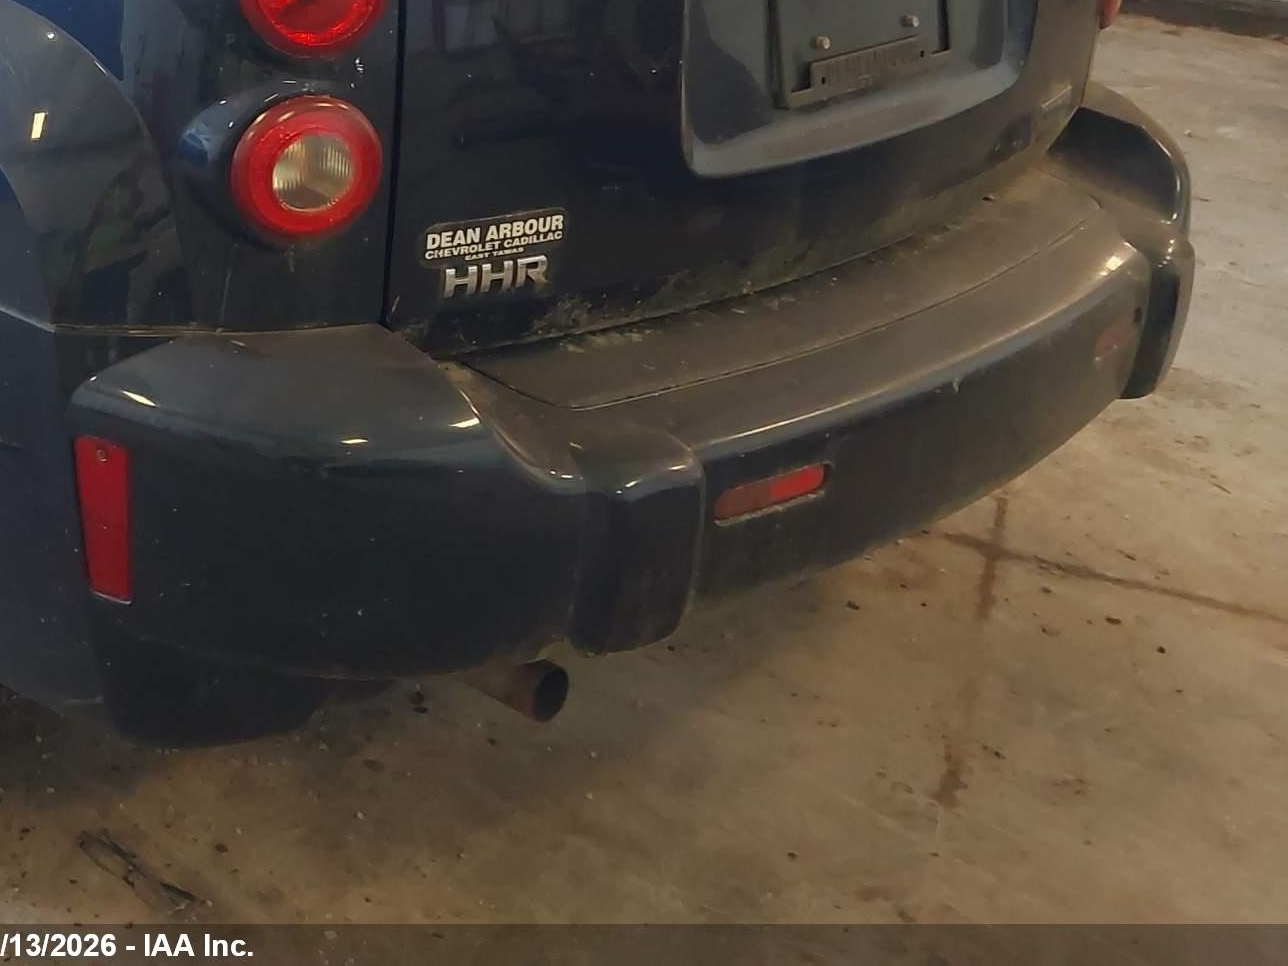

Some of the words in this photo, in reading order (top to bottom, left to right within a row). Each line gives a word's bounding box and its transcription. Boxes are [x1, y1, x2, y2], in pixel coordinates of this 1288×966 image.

[425, 241, 502, 260] CHEVROLET
[503, 231, 562, 248] CADILLAC
[426, 227, 481, 250] DEAN
[486, 215, 564, 241] ARBOUR
[464, 251, 490, 261] EAST
[444, 255, 548, 298] HHR
